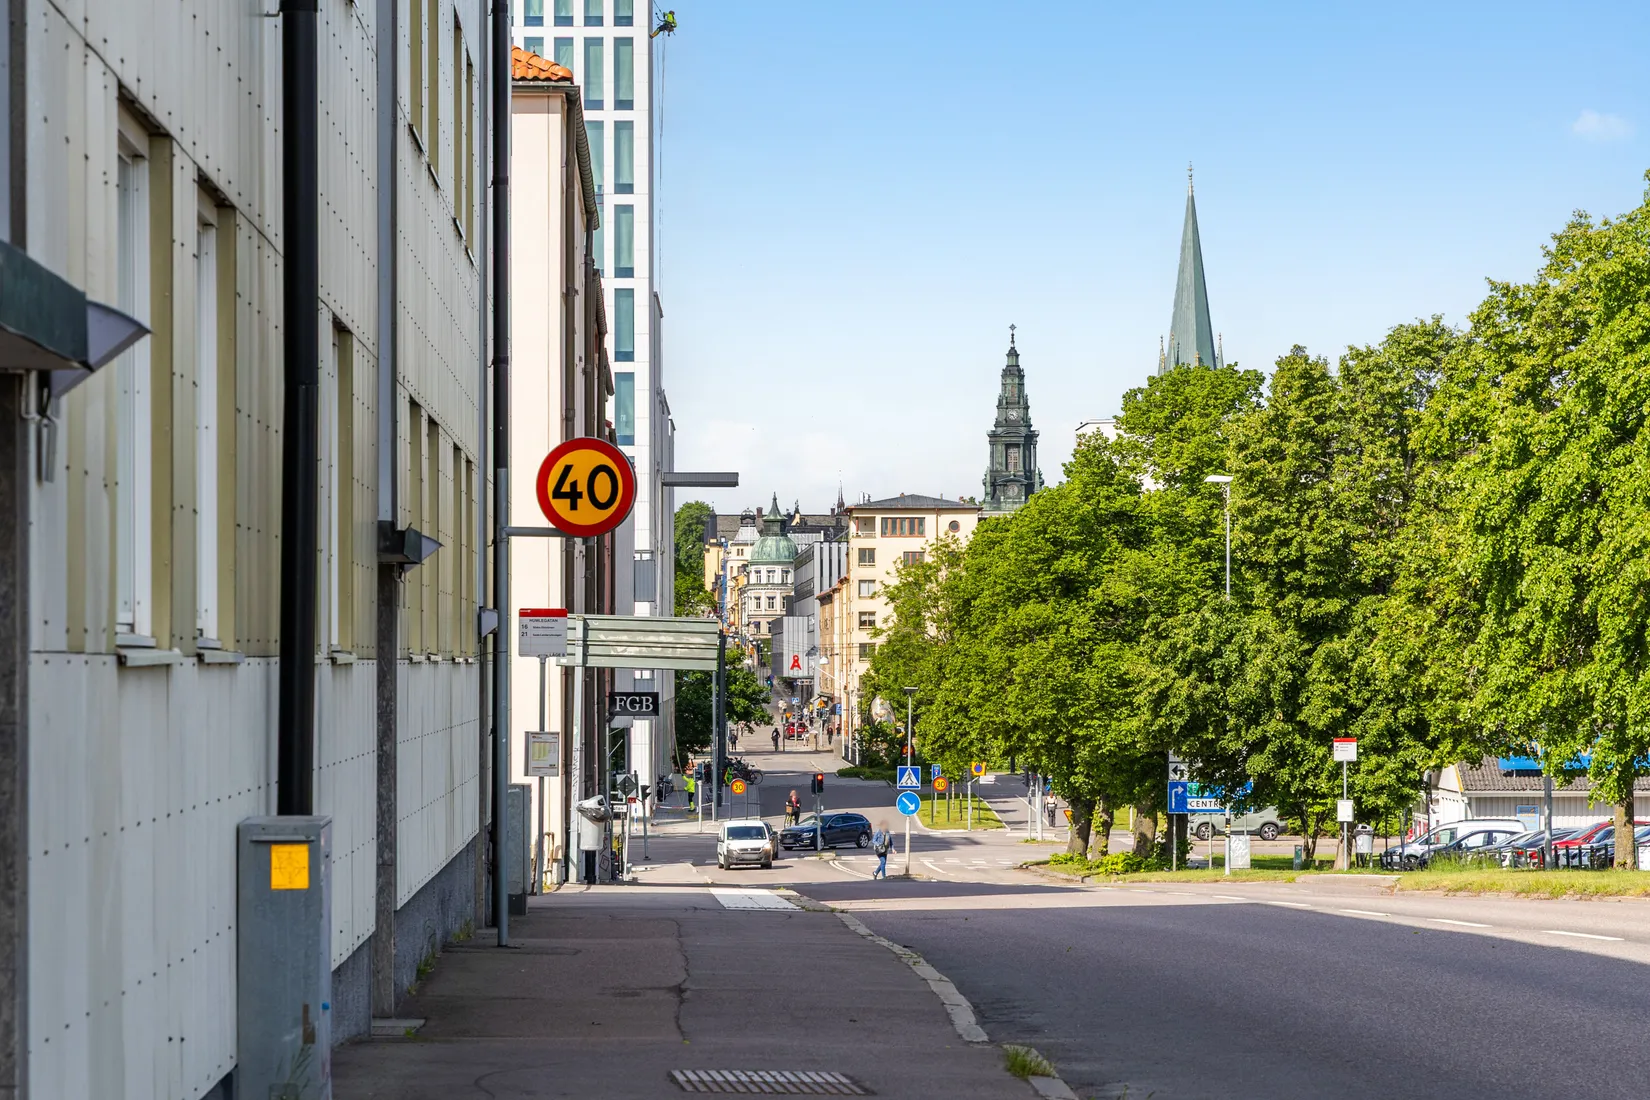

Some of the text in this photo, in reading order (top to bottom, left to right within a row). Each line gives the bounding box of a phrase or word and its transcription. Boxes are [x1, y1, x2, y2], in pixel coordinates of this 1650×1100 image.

[552, 464, 619, 511] 40
[614, 696, 654, 712] FGB
[734, 783, 744, 791] 30
[936, 780, 946, 788] 30
[1189, 800, 1220, 808] CENTR
